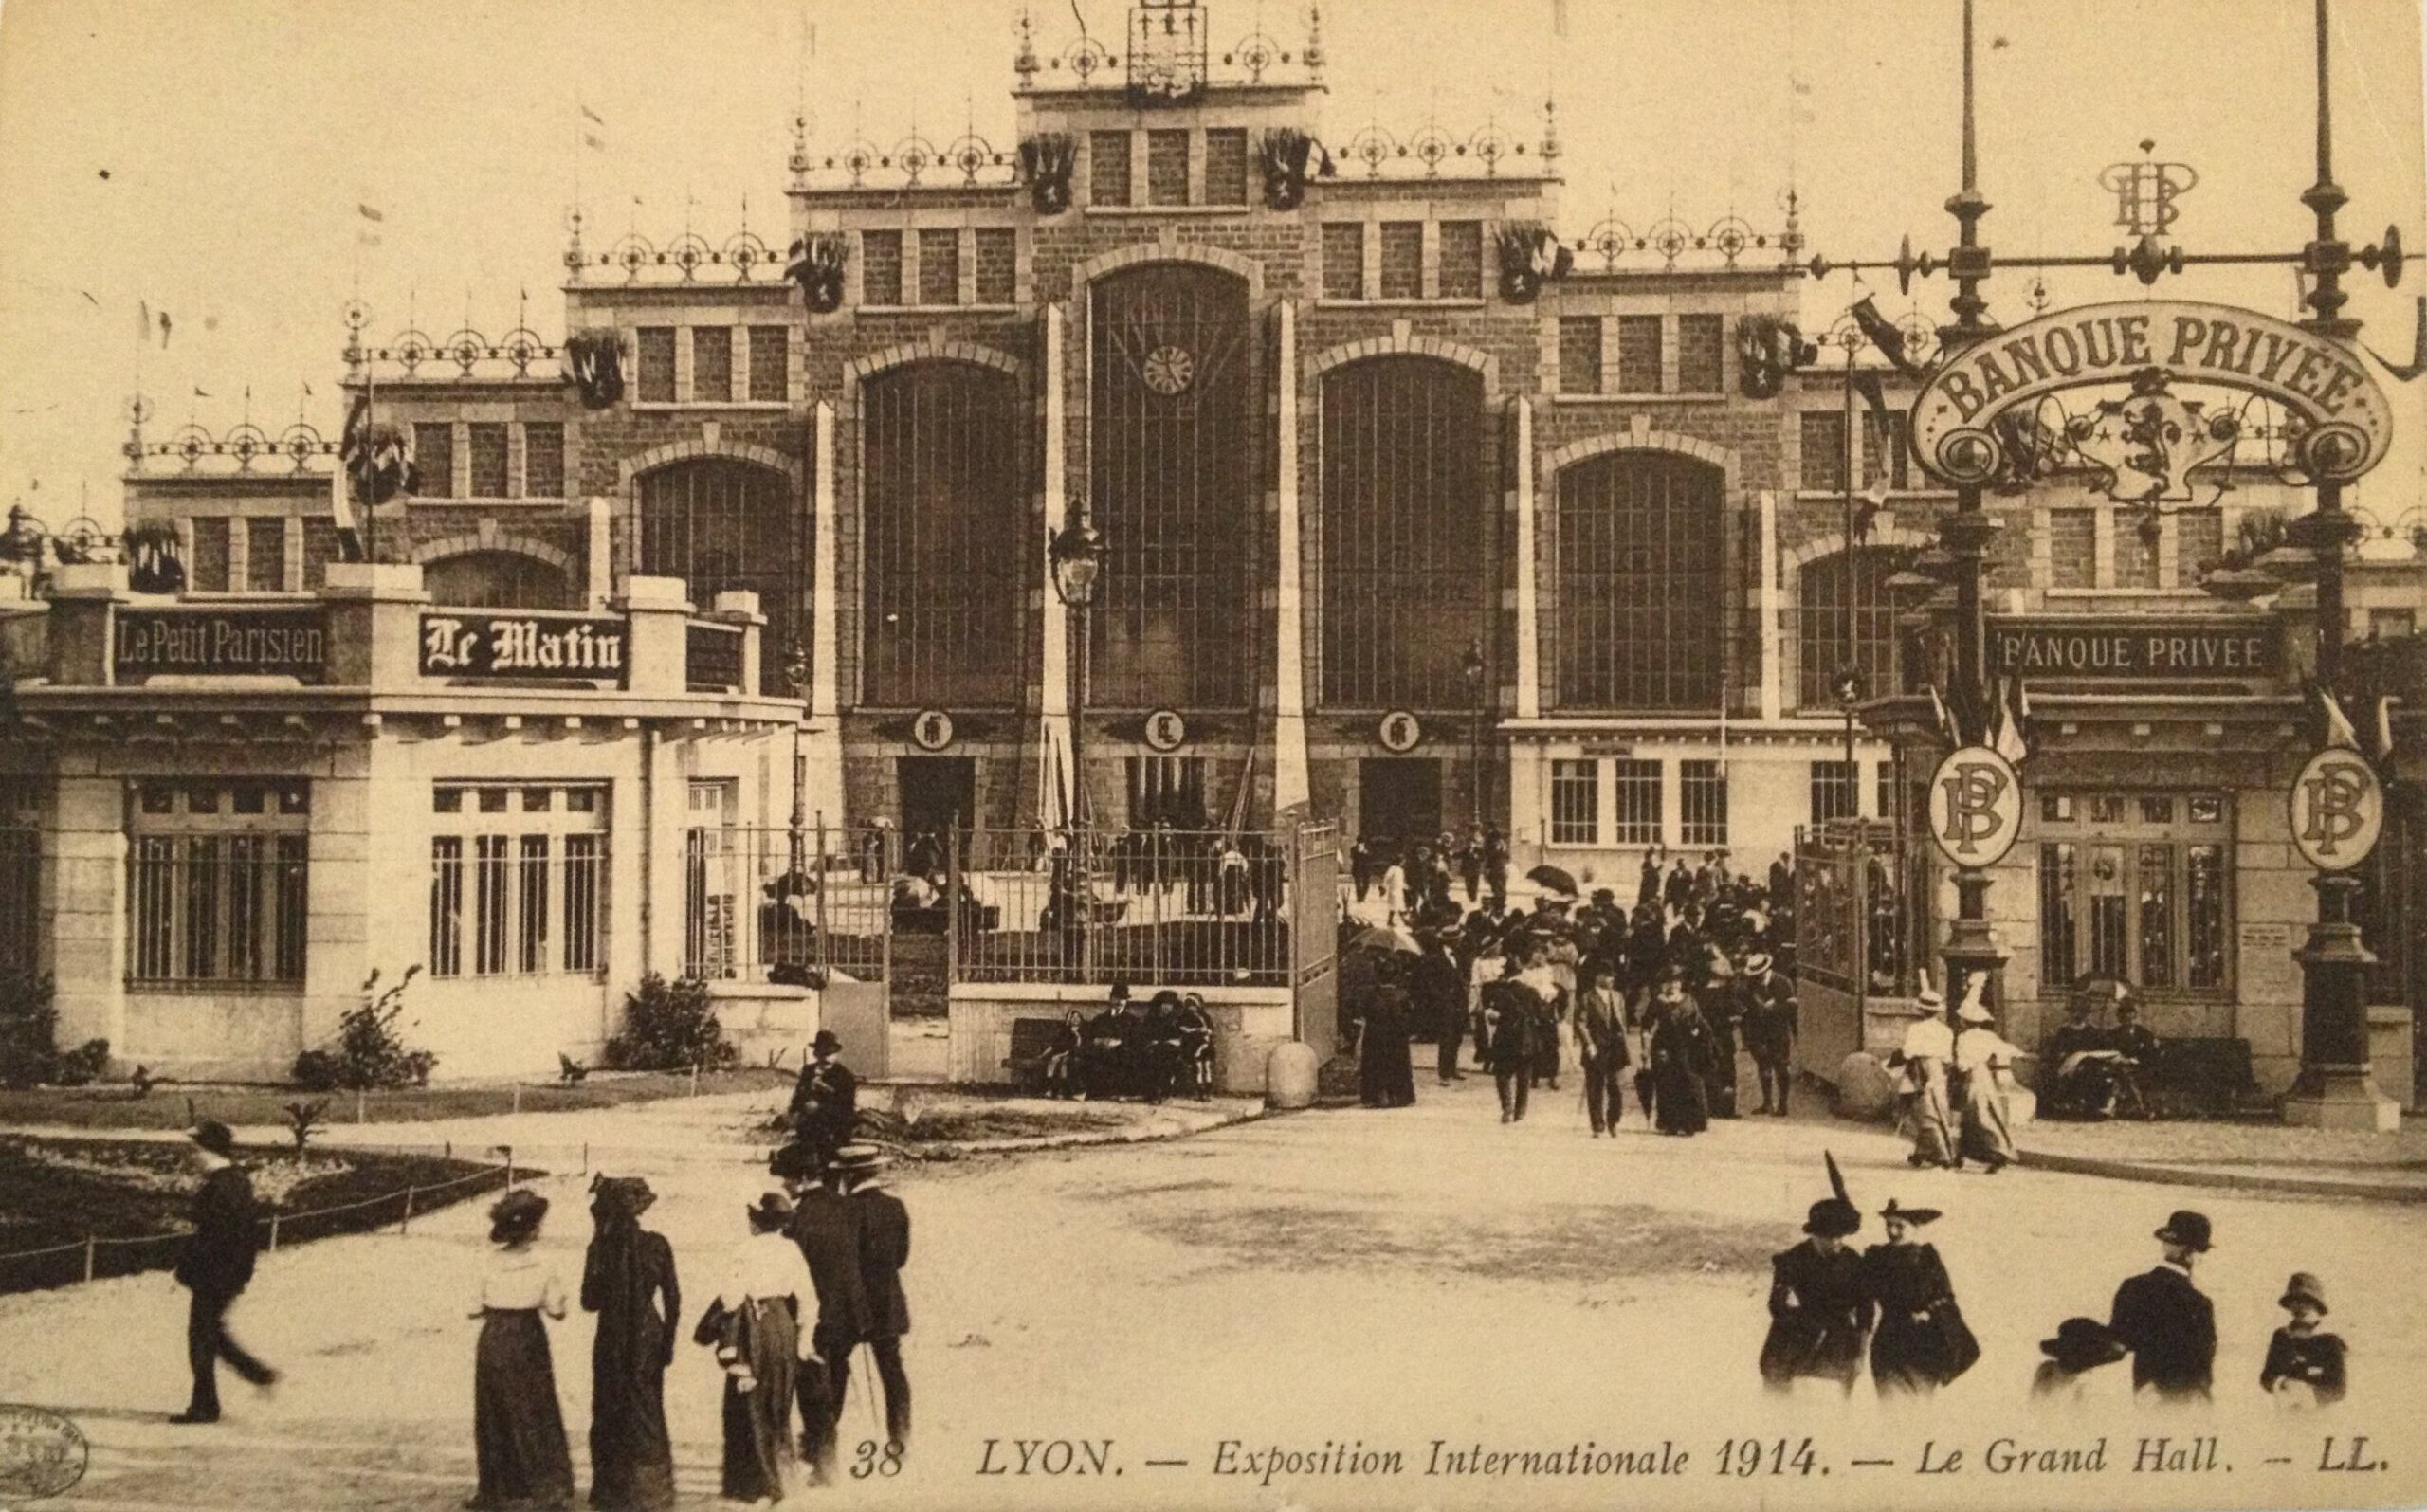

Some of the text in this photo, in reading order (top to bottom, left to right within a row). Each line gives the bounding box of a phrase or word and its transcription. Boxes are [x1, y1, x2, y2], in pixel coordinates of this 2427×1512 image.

[1937, 314, 2152, 425] BANQUE
[119, 618, 324, 664] Le Petit Parisien
[426, 618, 621, 671] Le Matin
